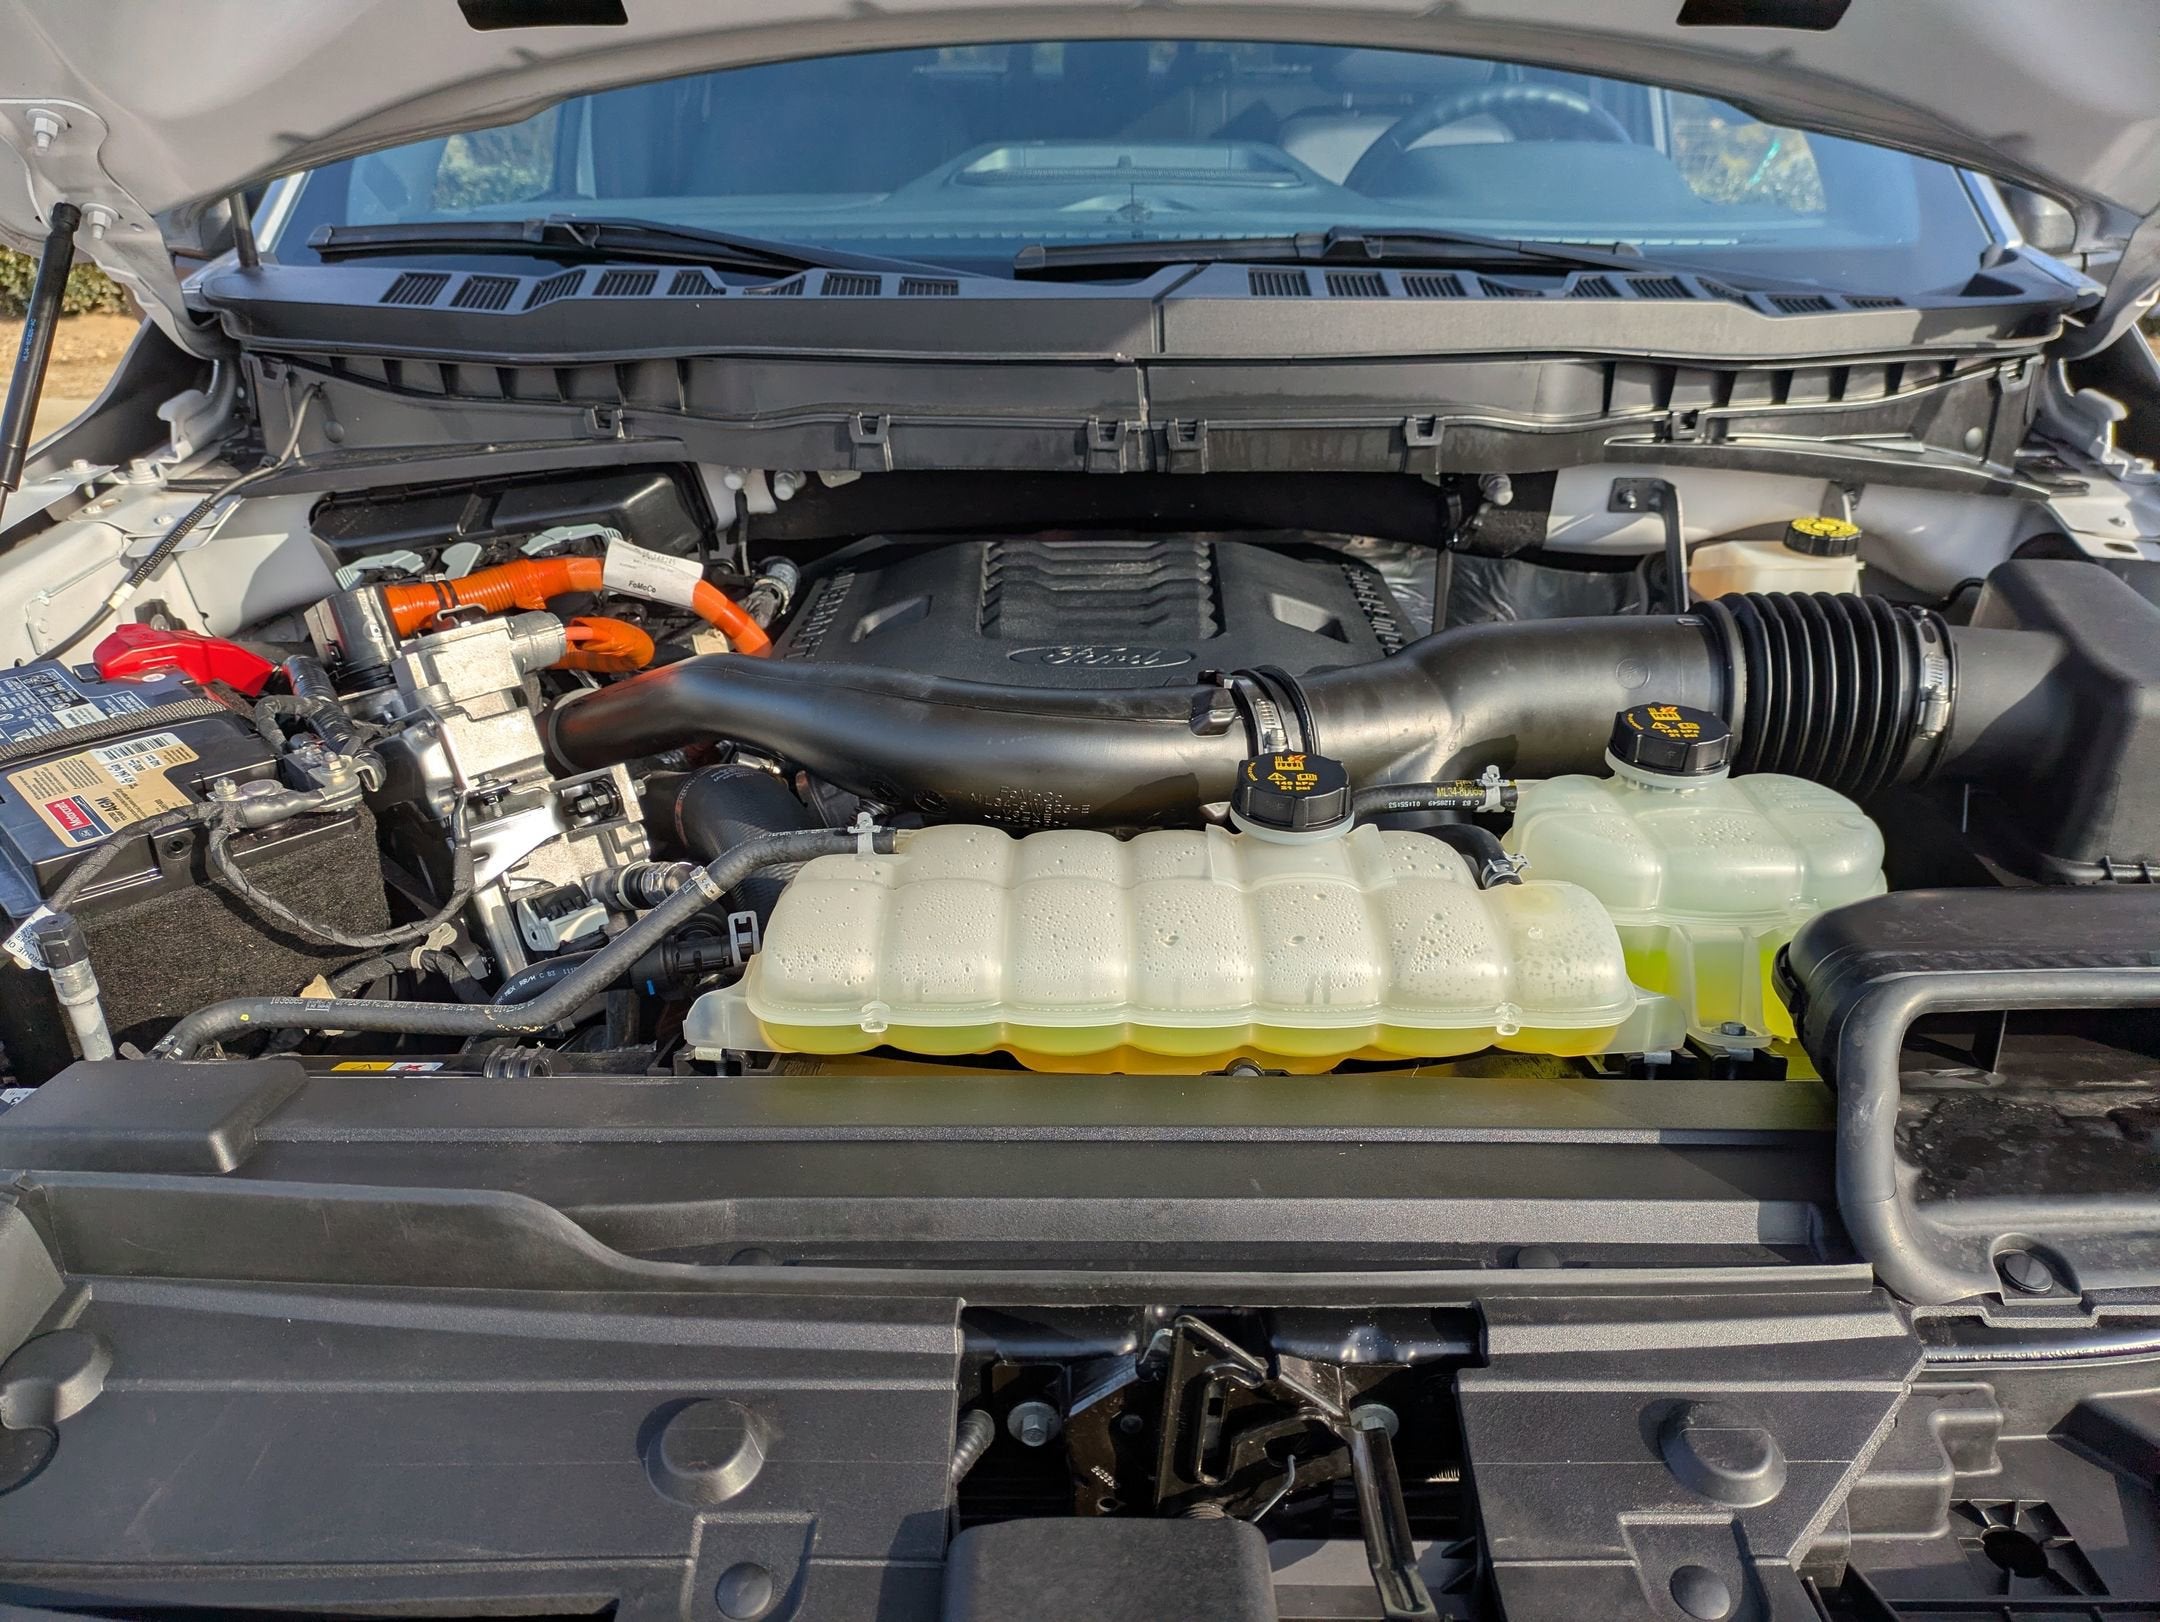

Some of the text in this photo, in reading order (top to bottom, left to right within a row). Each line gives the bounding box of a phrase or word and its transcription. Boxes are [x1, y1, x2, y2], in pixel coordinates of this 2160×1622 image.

[628, 580, 657, 593] FoMoCo
[1041, 646, 1162, 666] Ford
[95, 796, 118, 813] AGM
[55, 801, 82, 827] Motorcraft
[504, 986, 516, 996] MEX
